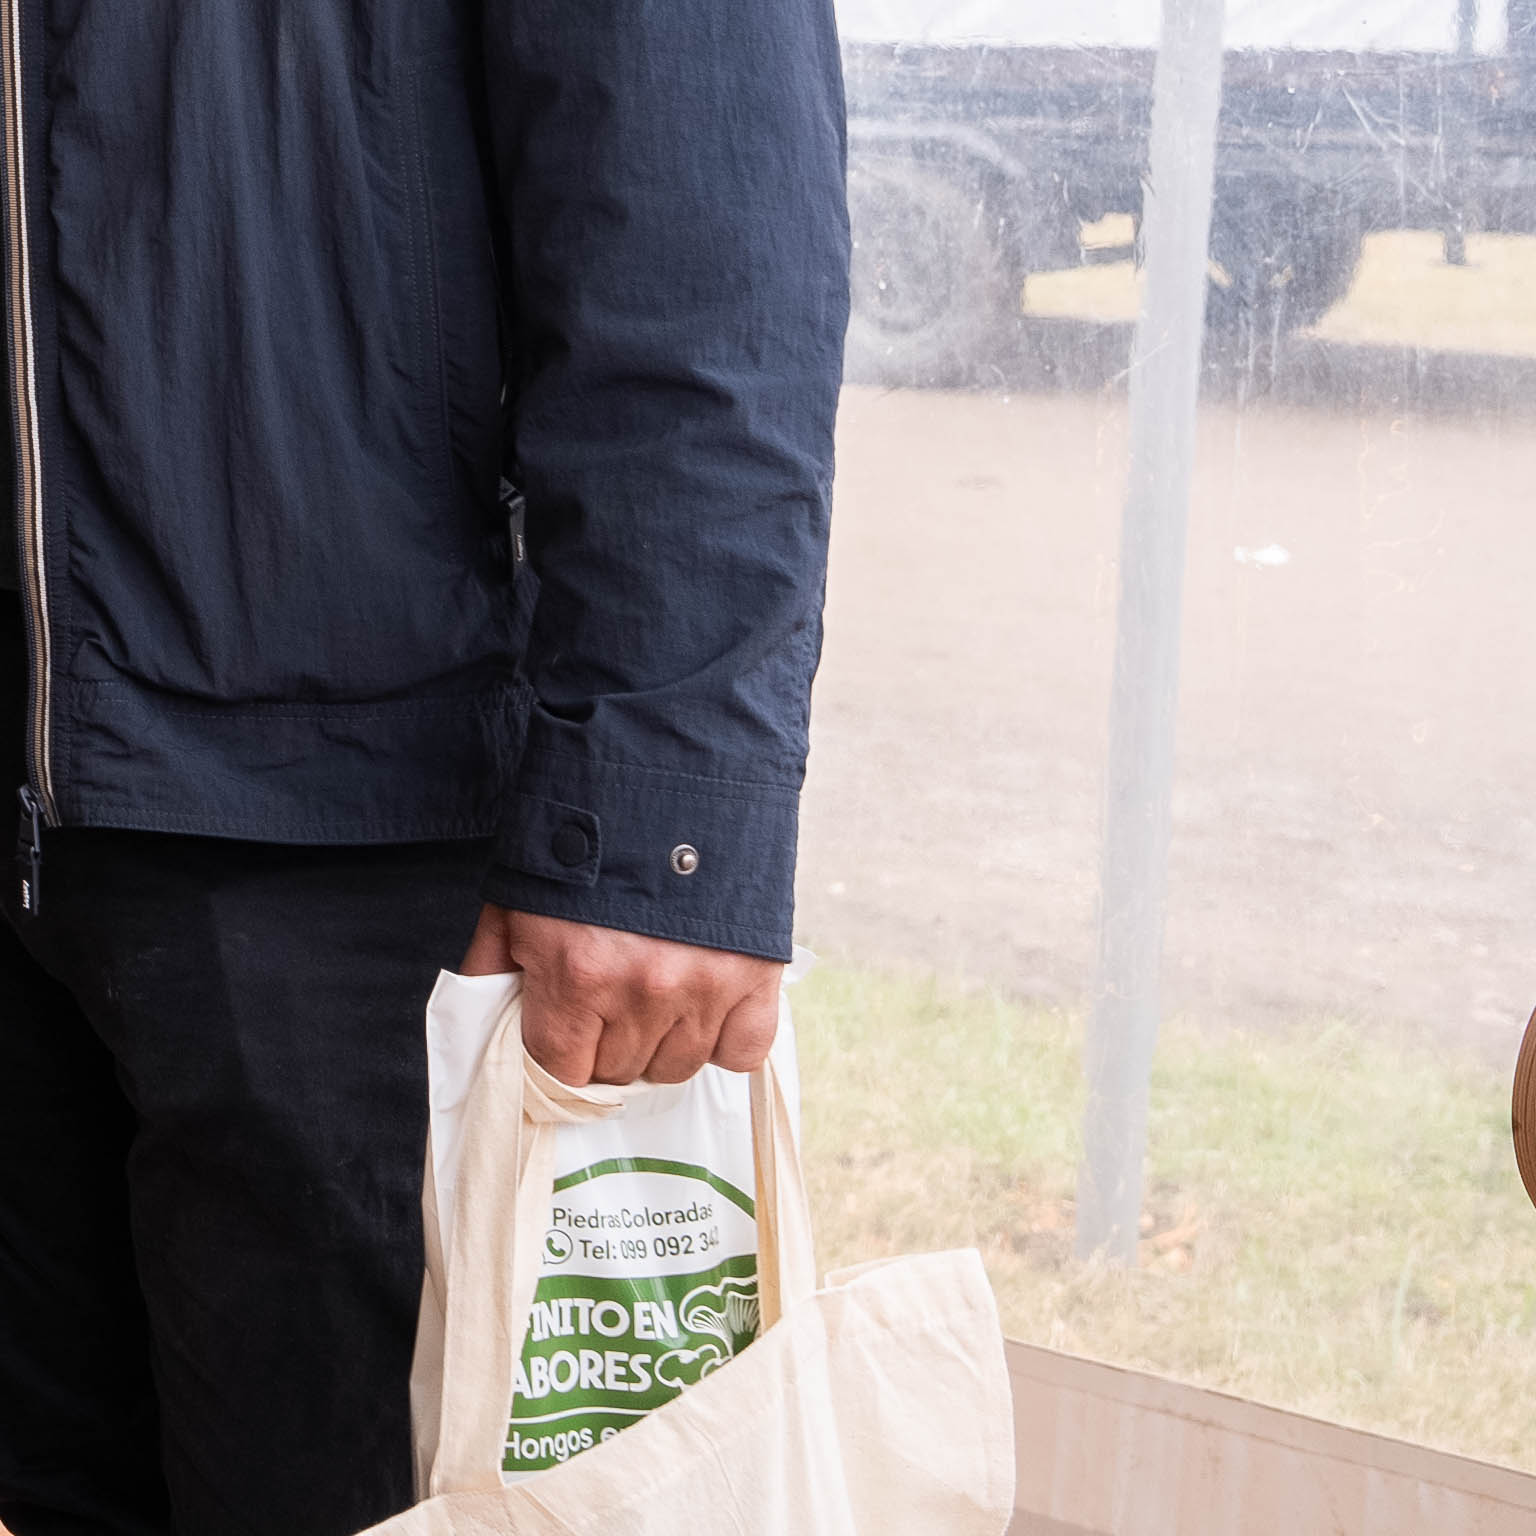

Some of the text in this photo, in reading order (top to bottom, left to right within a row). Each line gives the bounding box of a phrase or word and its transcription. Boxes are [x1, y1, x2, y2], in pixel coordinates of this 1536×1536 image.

[552, 1202, 713, 1229] Piedras Coloradas
[578, 1239, 618, 1260] Tel:
[620, 1239, 648, 1260] 099
[653, 1234, 695, 1259] 092
[632, 1300, 680, 1341] EN
[512, 1348, 653, 1400] ABORES
[504, 1426, 594, 1462] Hongos
